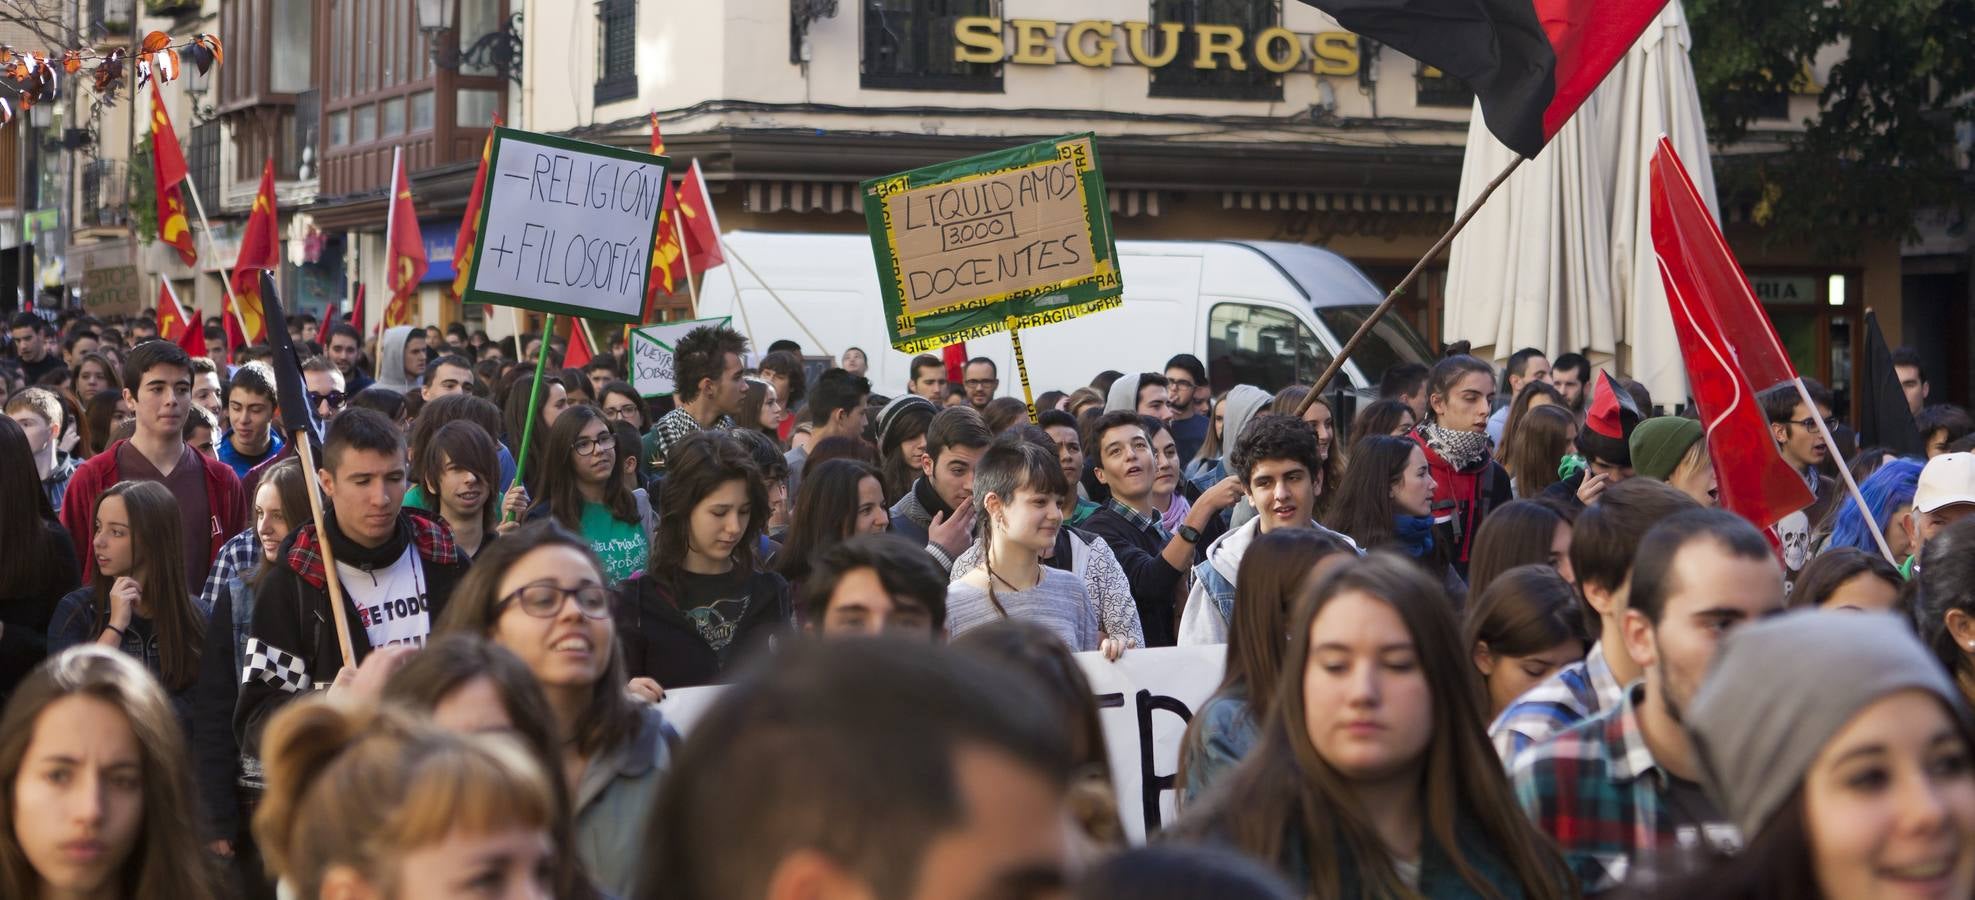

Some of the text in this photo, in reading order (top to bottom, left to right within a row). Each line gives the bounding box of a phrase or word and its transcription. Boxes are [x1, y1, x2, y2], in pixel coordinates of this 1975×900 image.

[954, 16, 1360, 76] SEGUROS
[909, 234, 1080, 301] DOCENTES
[635, 339, 673, 369] VUESTR
[384, 593, 430, 621] TODO
